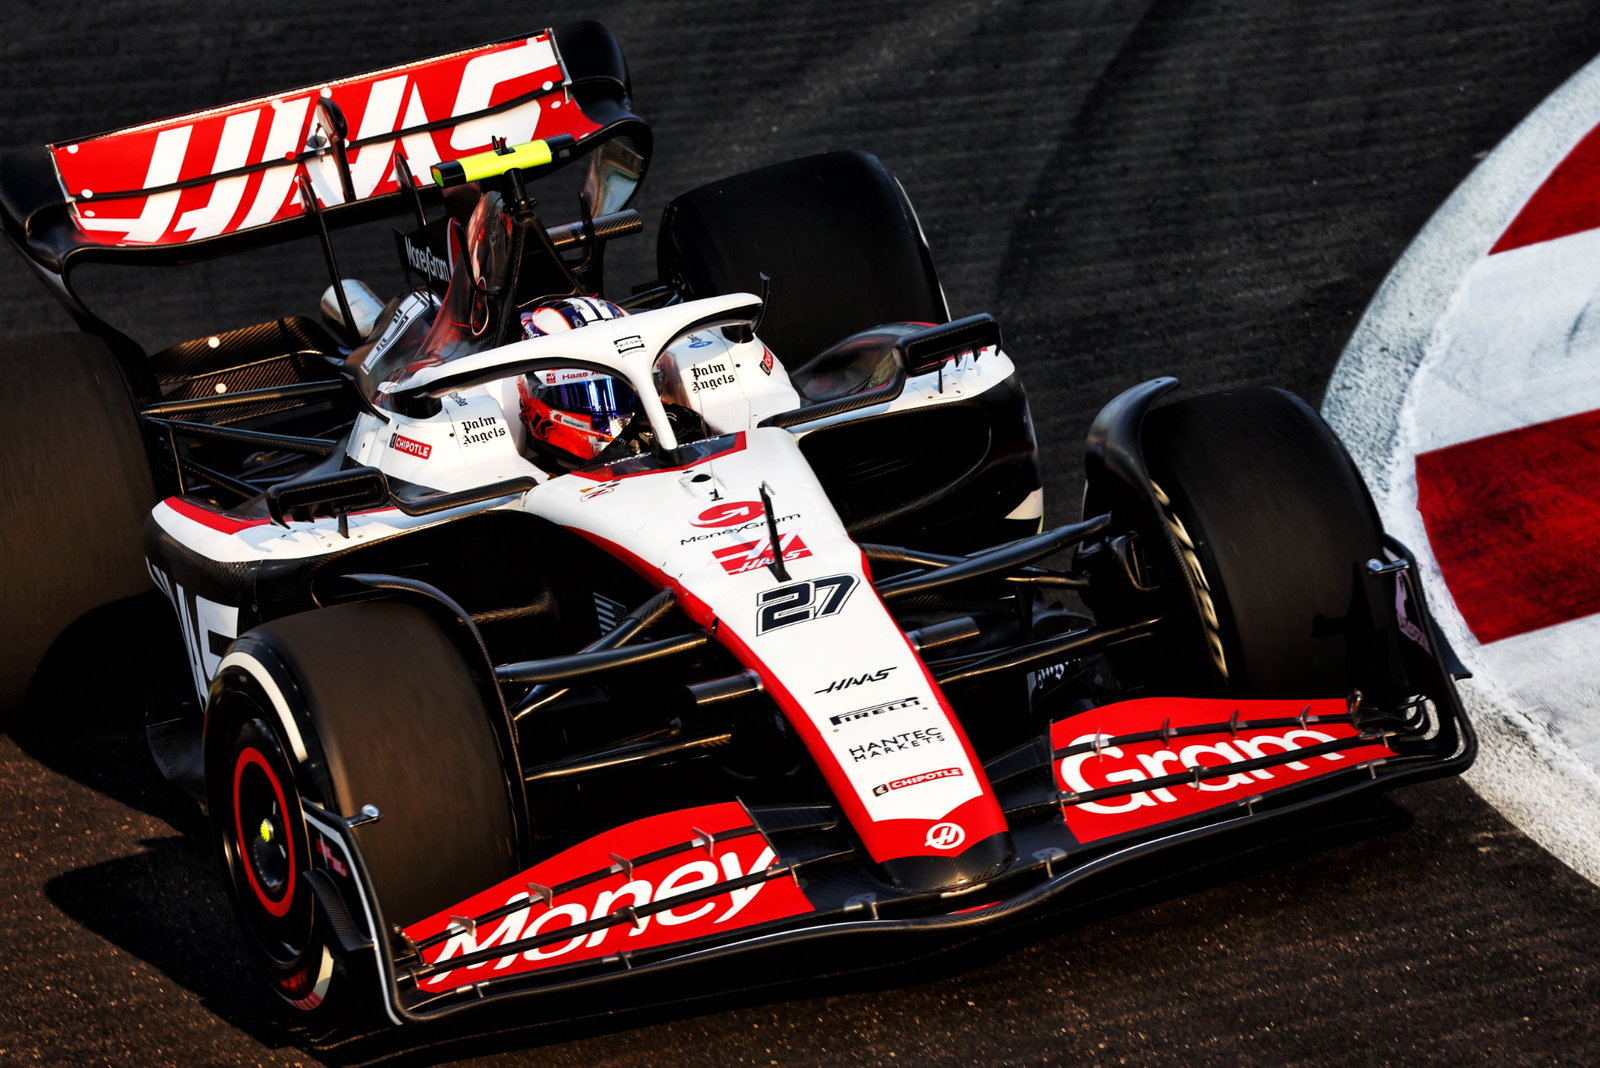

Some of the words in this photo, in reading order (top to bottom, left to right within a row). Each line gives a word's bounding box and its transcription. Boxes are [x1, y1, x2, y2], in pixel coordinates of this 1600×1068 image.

[79, 40, 563, 243] HAAS
[405, 236, 450, 282] MoneyGram
[562, 372, 589, 380] Haas
[691, 363, 726, 381] Palm
[692, 374, 735, 393] Angels
[461, 416, 496, 434] Palm
[463, 426, 506, 446] Angels
[395, 436, 431, 458] CHIPOTLE
[756, 572, 861, 637] 27
[814, 666, 898, 694] HAAS
[829, 696, 921, 726] PIRELLI
[849, 727, 942, 756] HANTEC
[854, 735, 946, 762] MARKETS
[891, 769, 961, 789] CHIPOTLE
[1061, 729, 1345, 814] Gram
[427, 846, 777, 985] Money
